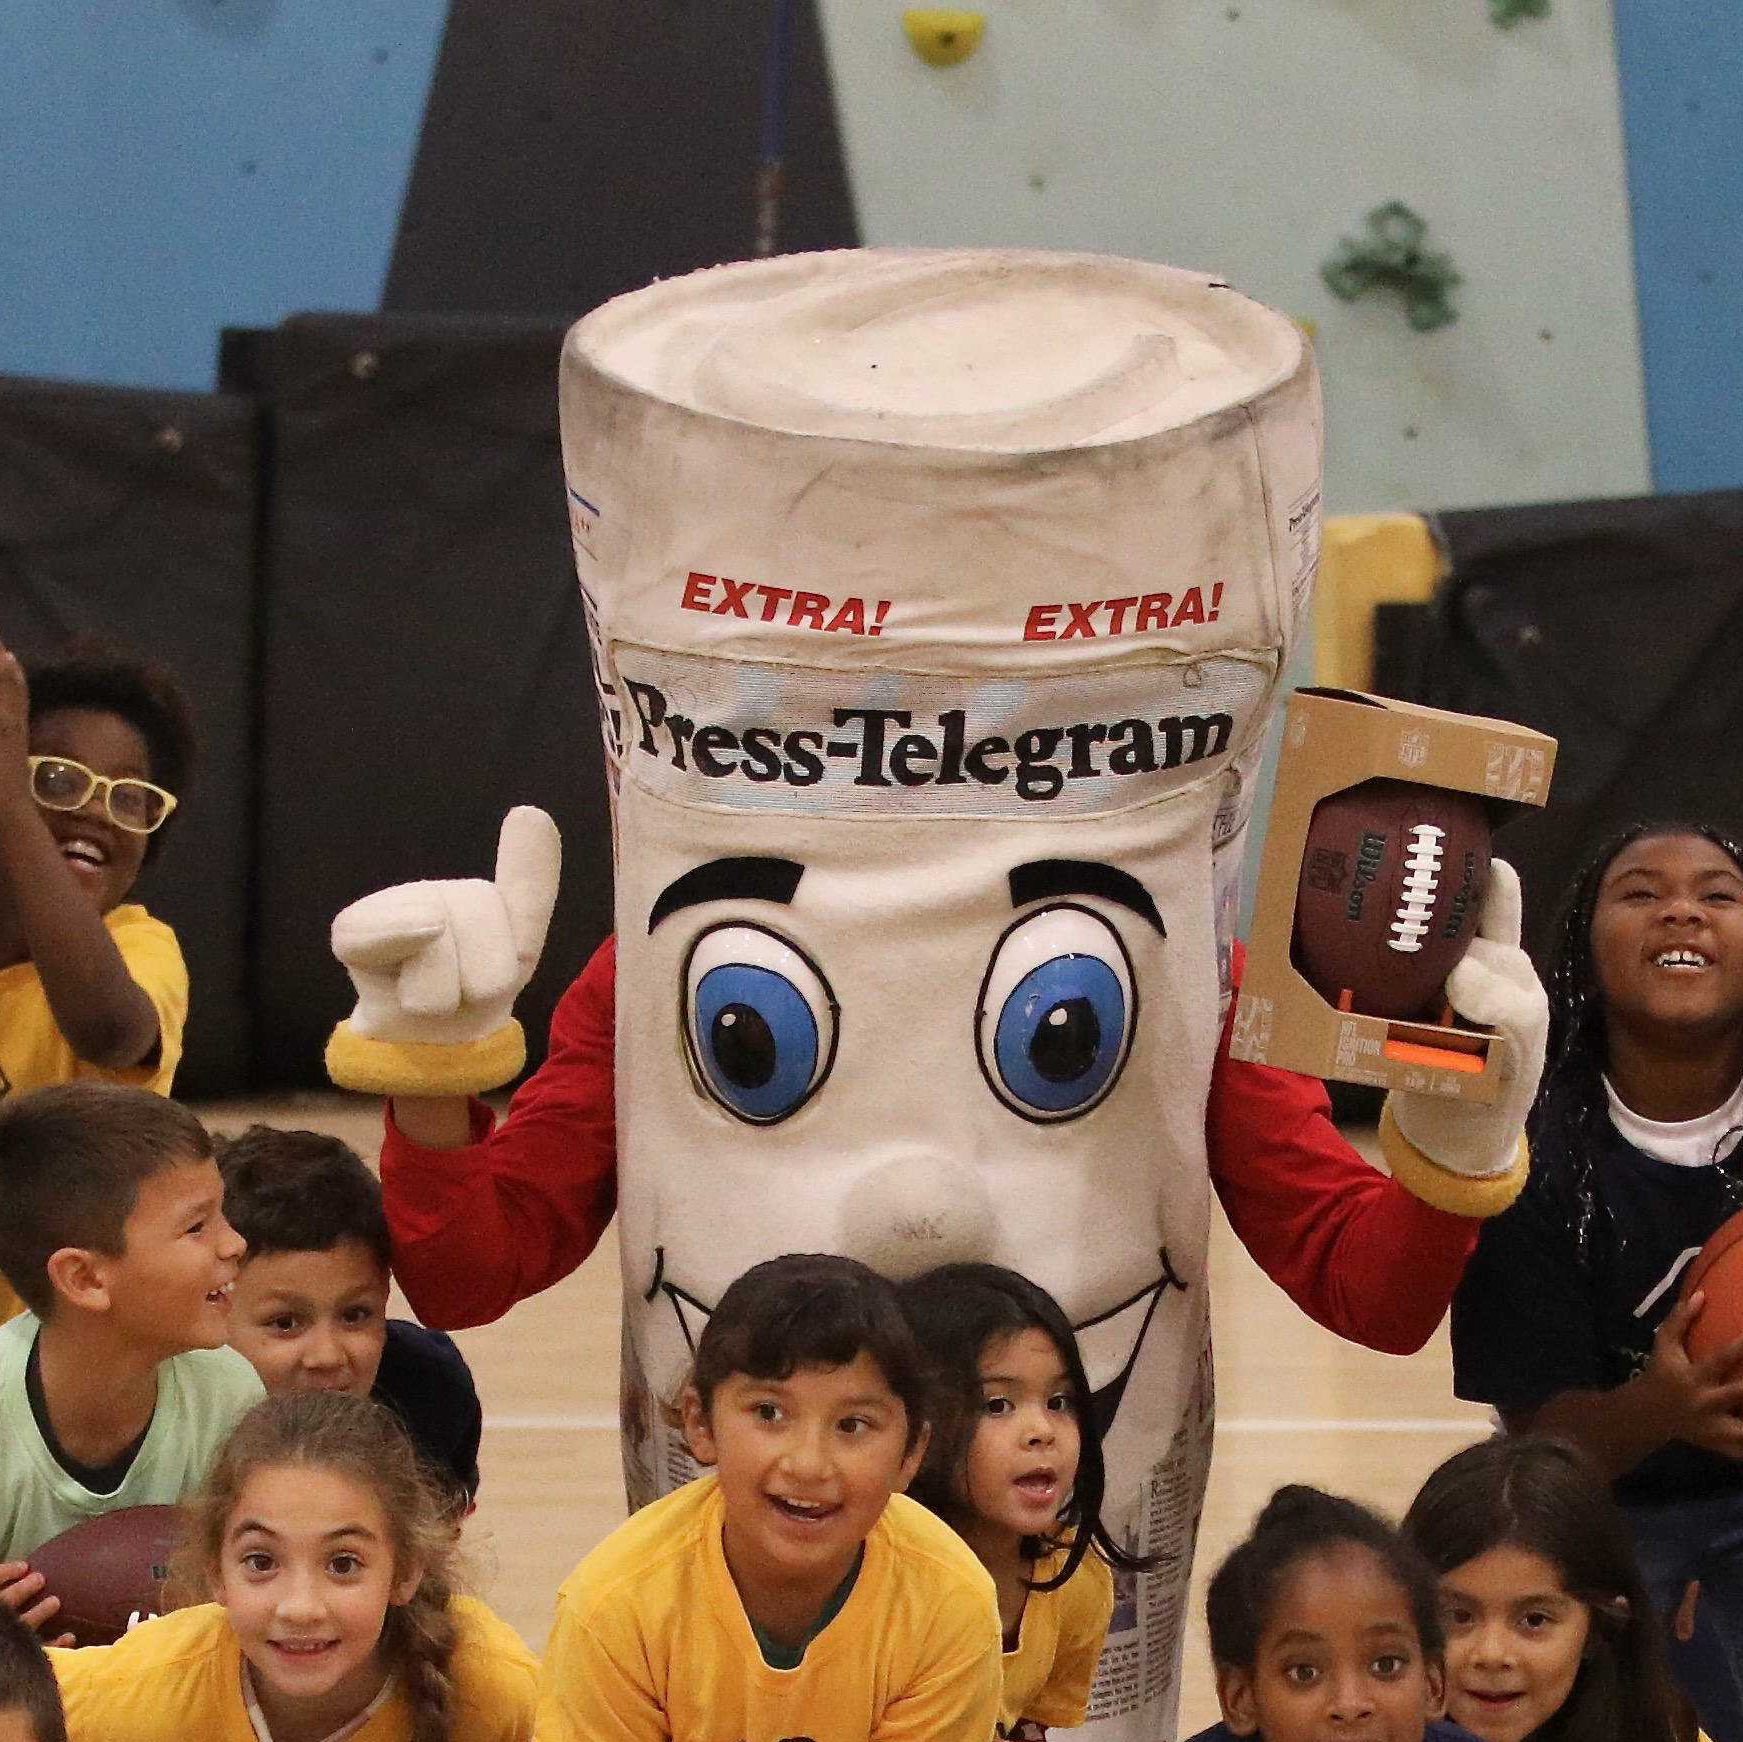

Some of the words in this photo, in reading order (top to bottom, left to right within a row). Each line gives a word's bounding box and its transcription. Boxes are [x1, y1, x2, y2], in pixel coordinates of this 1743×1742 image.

[680, 571, 892, 638] EXTRA!
[1021, 581, 1225, 642] EXTRA!
[622, 676, 1233, 801] Press-Telegram
